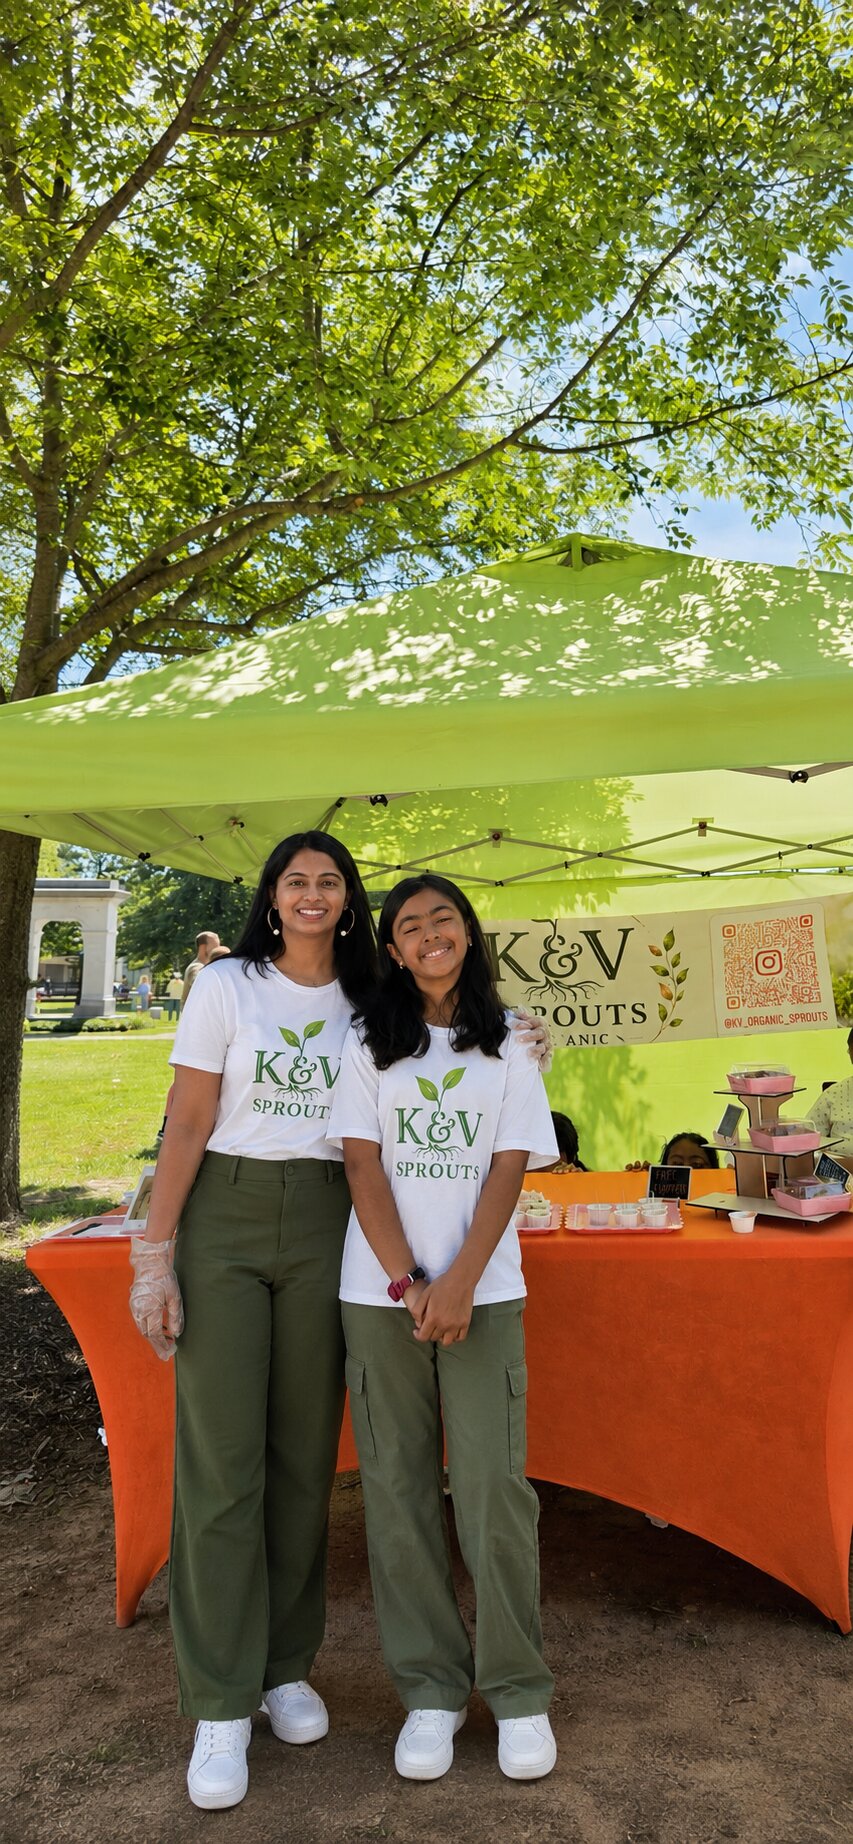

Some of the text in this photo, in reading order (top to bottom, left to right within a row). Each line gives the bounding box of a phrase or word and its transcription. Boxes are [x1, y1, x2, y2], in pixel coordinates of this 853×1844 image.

[483, 928, 635, 982] K&V
[724, 1011, 829, 1029] @KV_ORGANIC_SPROUTS
[252, 1050, 342, 1090] K&V
[253, 1098, 332, 1120] SPROUT
[395, 1107, 484, 1148] K&V
[396, 1161, 480, 1180] SPROUTS
